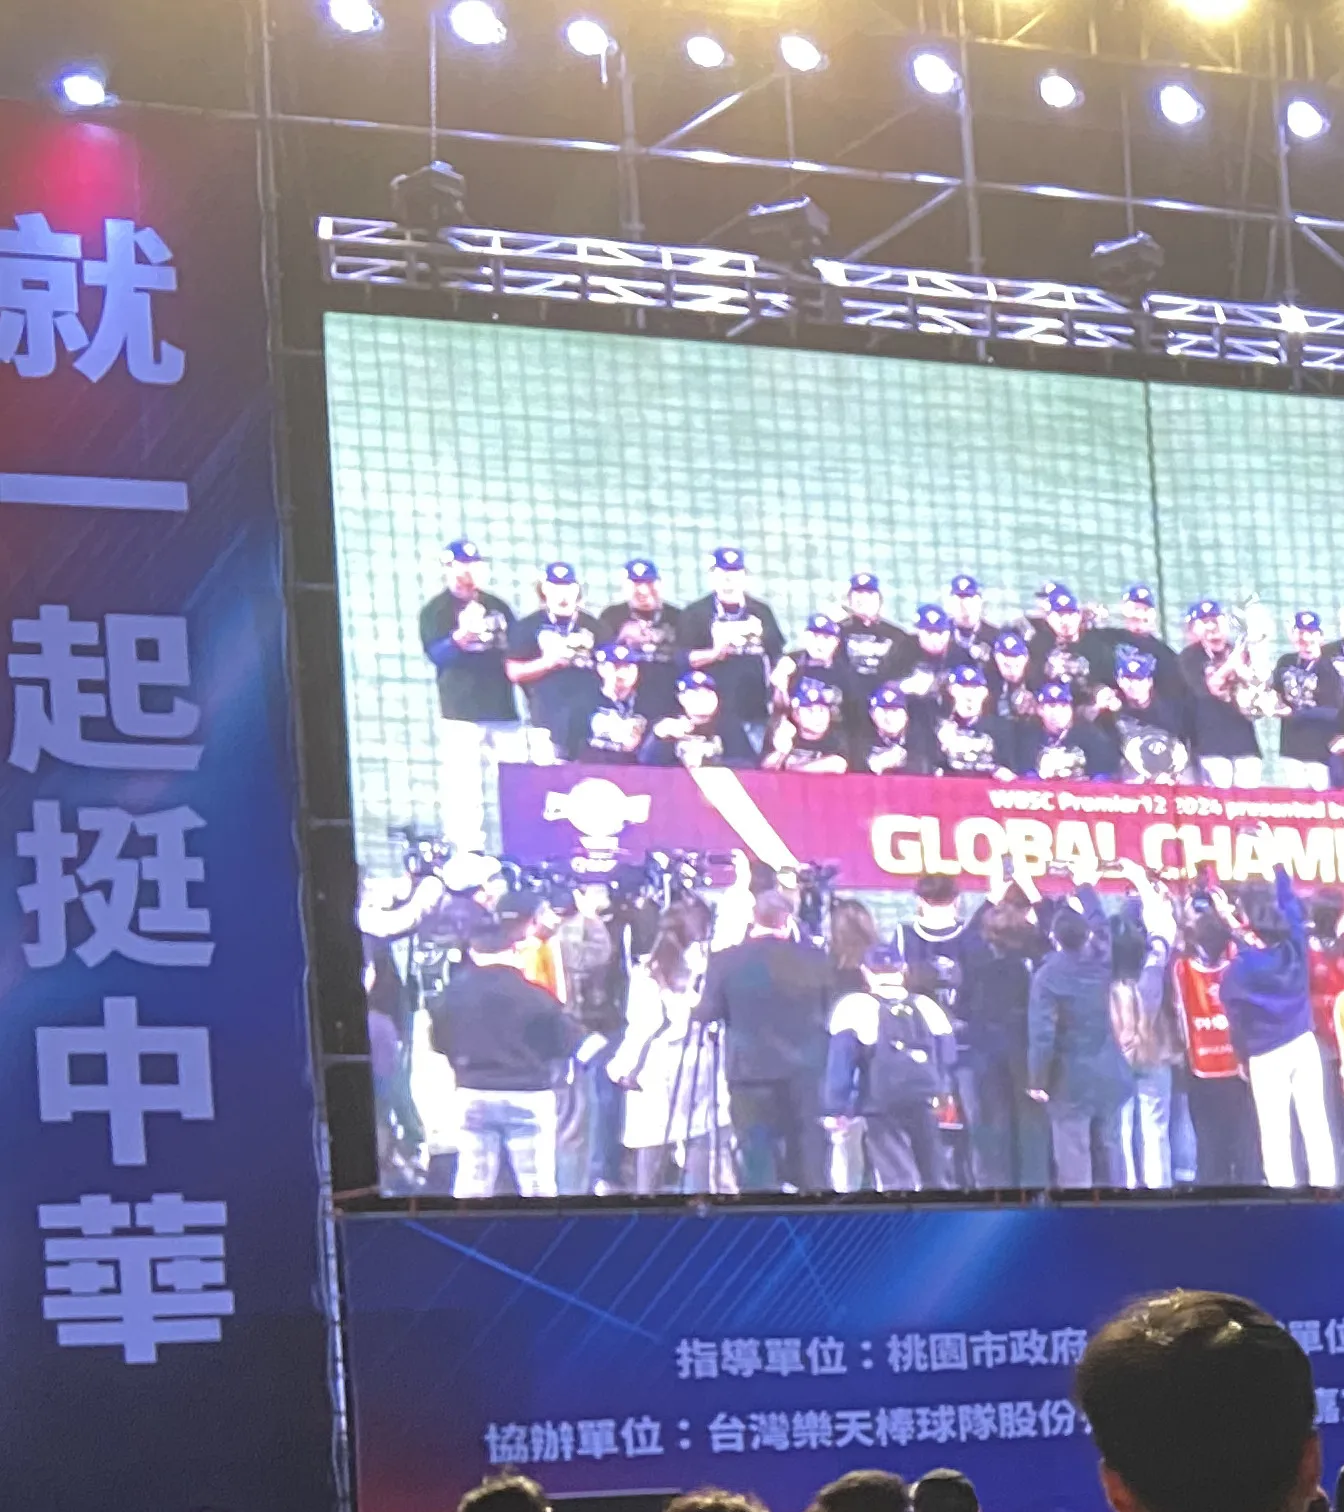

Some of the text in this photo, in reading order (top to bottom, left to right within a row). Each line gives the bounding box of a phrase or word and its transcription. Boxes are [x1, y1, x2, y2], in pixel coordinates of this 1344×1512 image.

[0, 212, 235, 1366] 就一起挺中華
[870, 813, 1117, 878] GLOBAL
[675, 1326, 1089, 1381] 指導單位：桃園市政府
[484, 1398, 1093, 1466] 協辦單位：台灣樂天棒球隊股份
